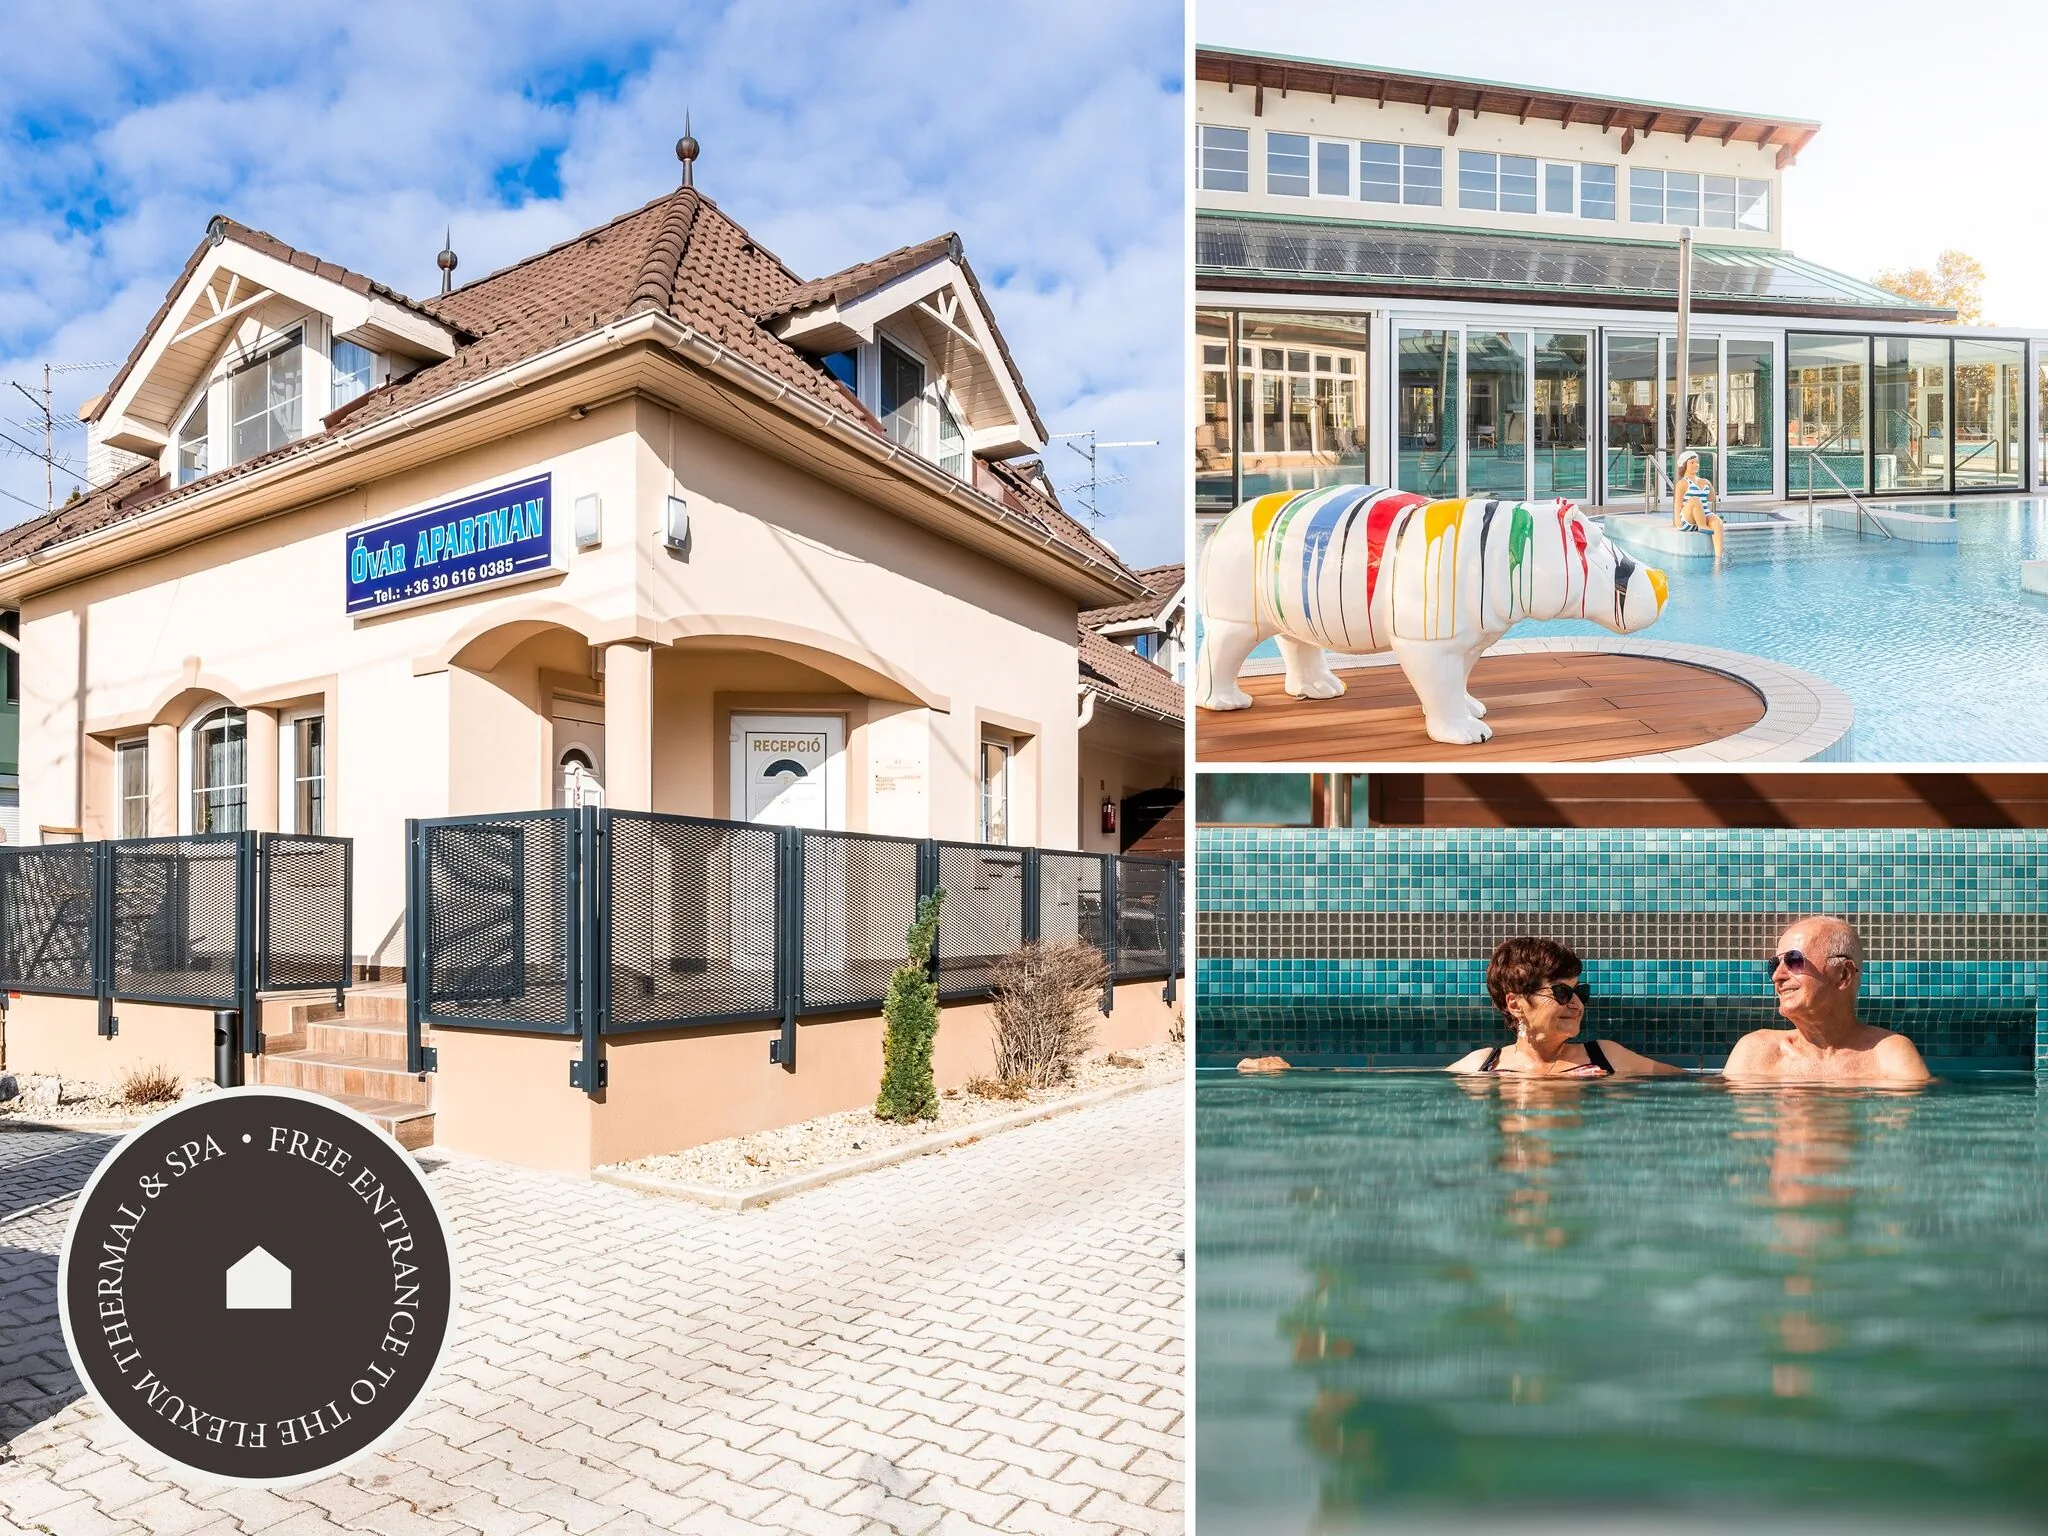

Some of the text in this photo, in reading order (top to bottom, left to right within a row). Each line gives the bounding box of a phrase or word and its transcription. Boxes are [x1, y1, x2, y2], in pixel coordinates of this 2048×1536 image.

[414, 497, 544, 568] APARTMAN
[374, 557, 514, 604] Tel.: +36 30 616 0385
[753, 737, 821, 753] RECEPCIÓ
